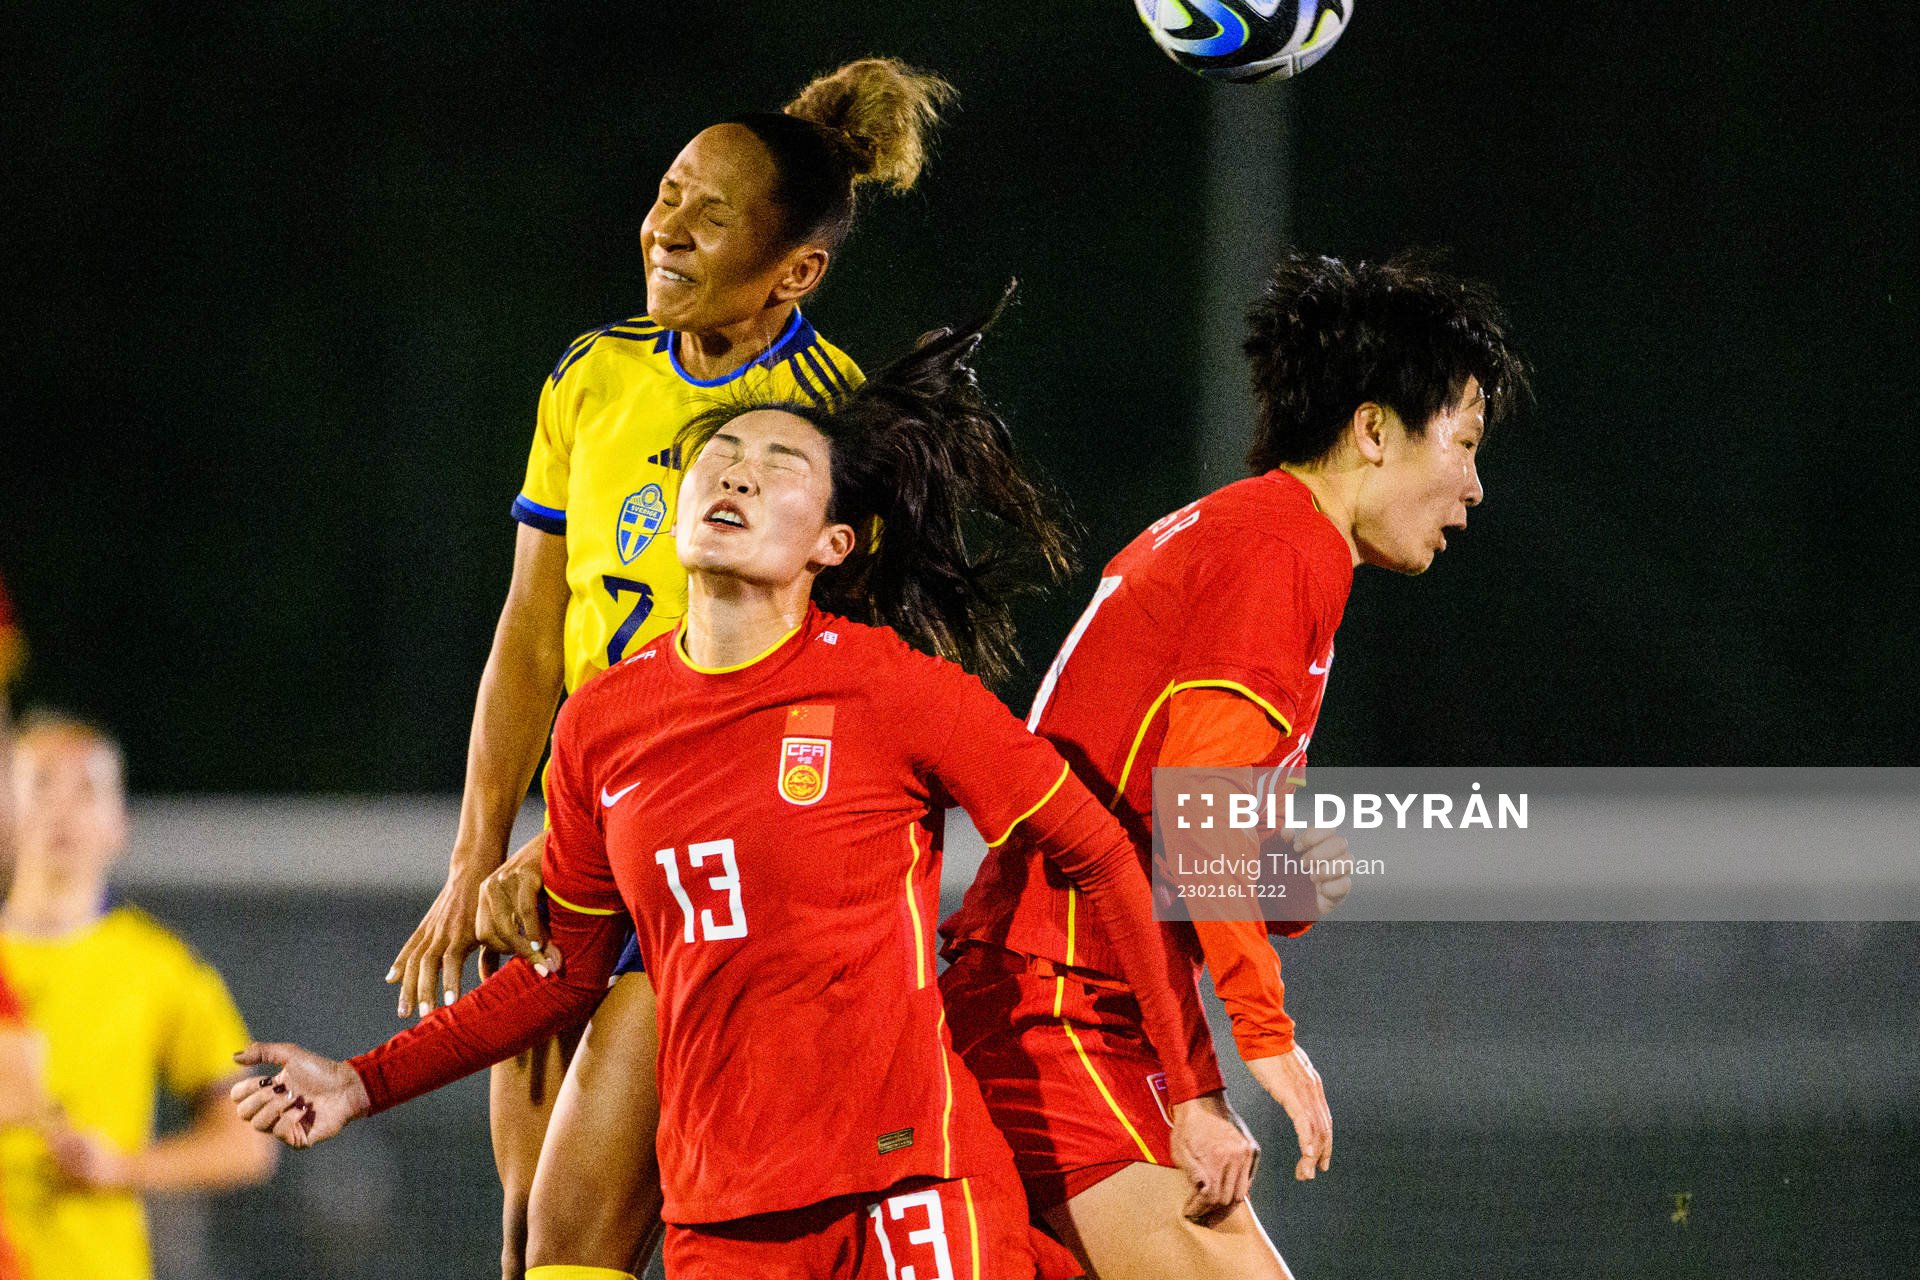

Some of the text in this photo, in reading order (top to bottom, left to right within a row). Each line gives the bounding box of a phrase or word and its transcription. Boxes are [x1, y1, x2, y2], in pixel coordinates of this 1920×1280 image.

[602, 575, 654, 667] 7
[787, 744, 825, 757] CFA
[655, 838, 748, 943] 13
[868, 1190, 955, 1280] 13
